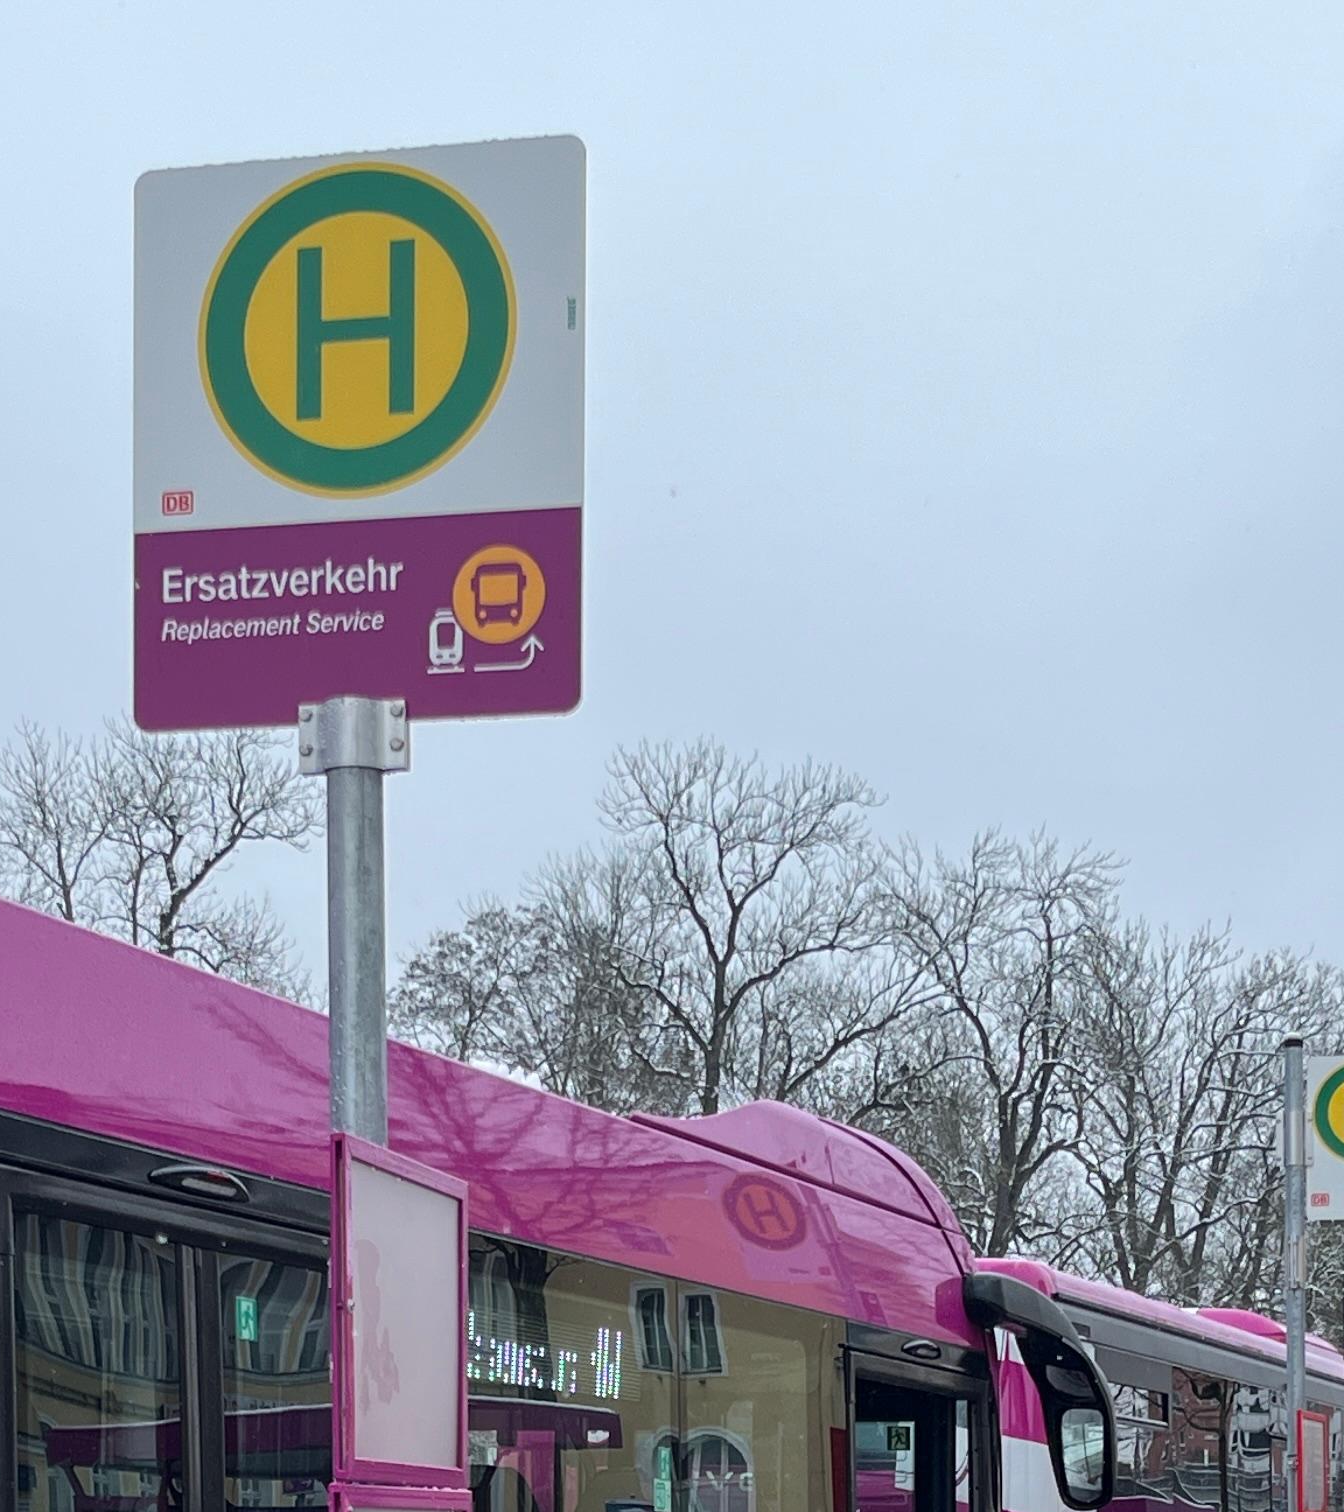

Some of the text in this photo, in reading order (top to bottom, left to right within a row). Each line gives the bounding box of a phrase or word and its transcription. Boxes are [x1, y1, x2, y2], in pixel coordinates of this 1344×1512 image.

[296, 238, 416, 422] H
[165, 494, 191, 513] DB
[162, 556, 404, 603] Ersatzverkehr
[161, 608, 385, 645] Replacement Service
